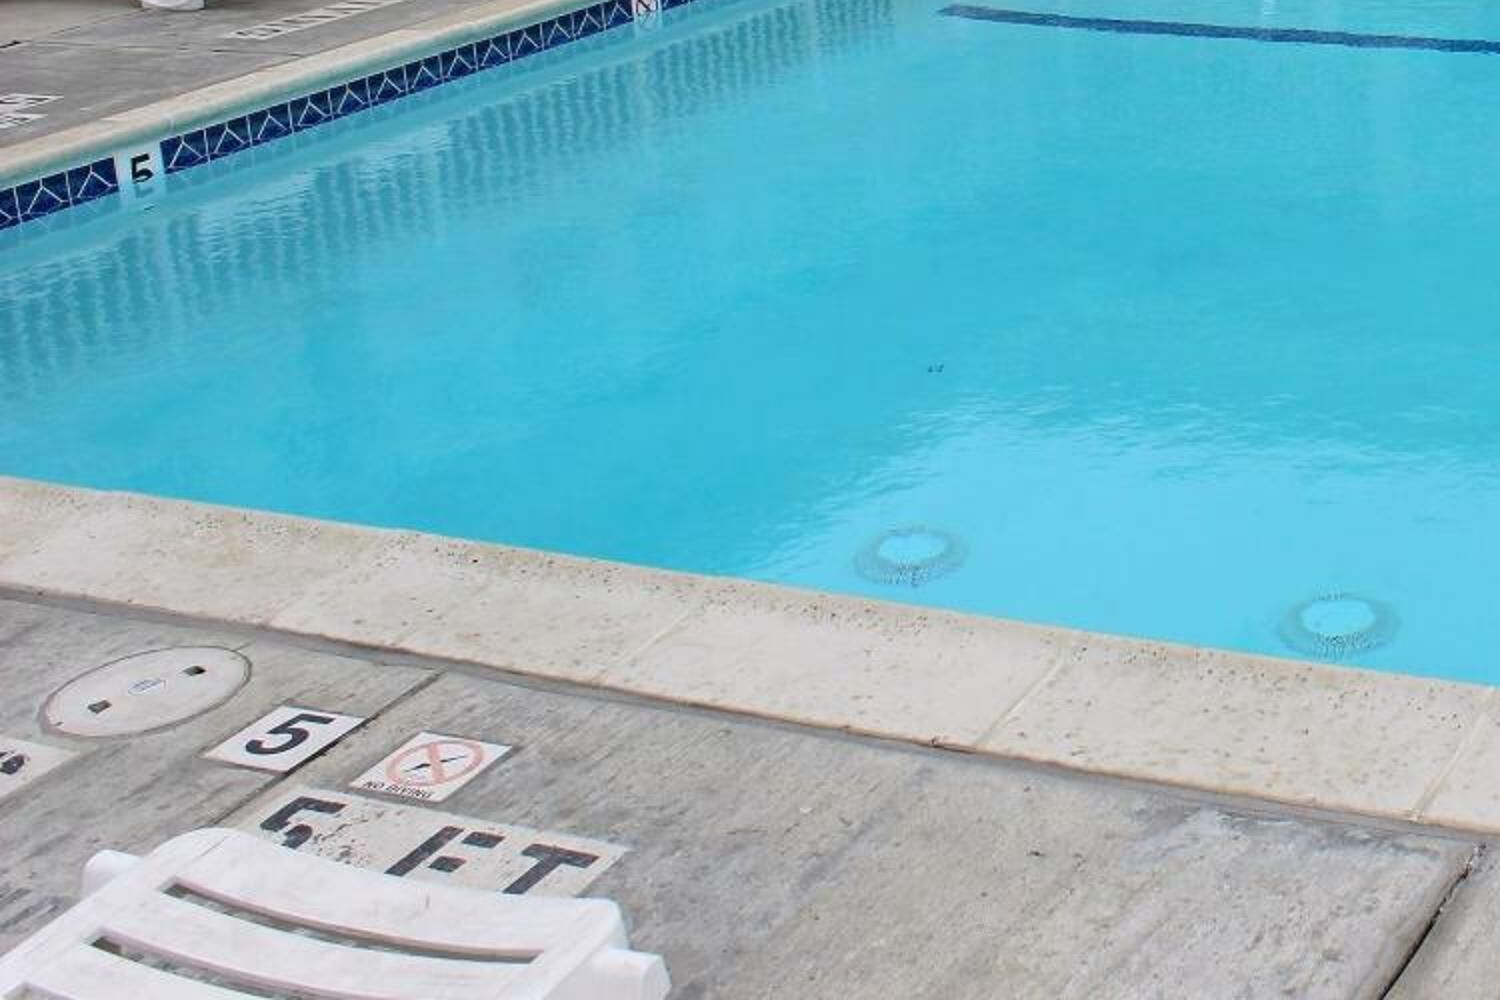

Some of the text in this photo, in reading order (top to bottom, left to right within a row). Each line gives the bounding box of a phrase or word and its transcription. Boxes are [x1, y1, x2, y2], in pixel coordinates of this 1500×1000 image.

[131, 152, 154, 184] 5
[244, 712, 336, 757] 5
[363, 780, 436, 800] NO DIVING
[383, 824, 601, 895] FT
